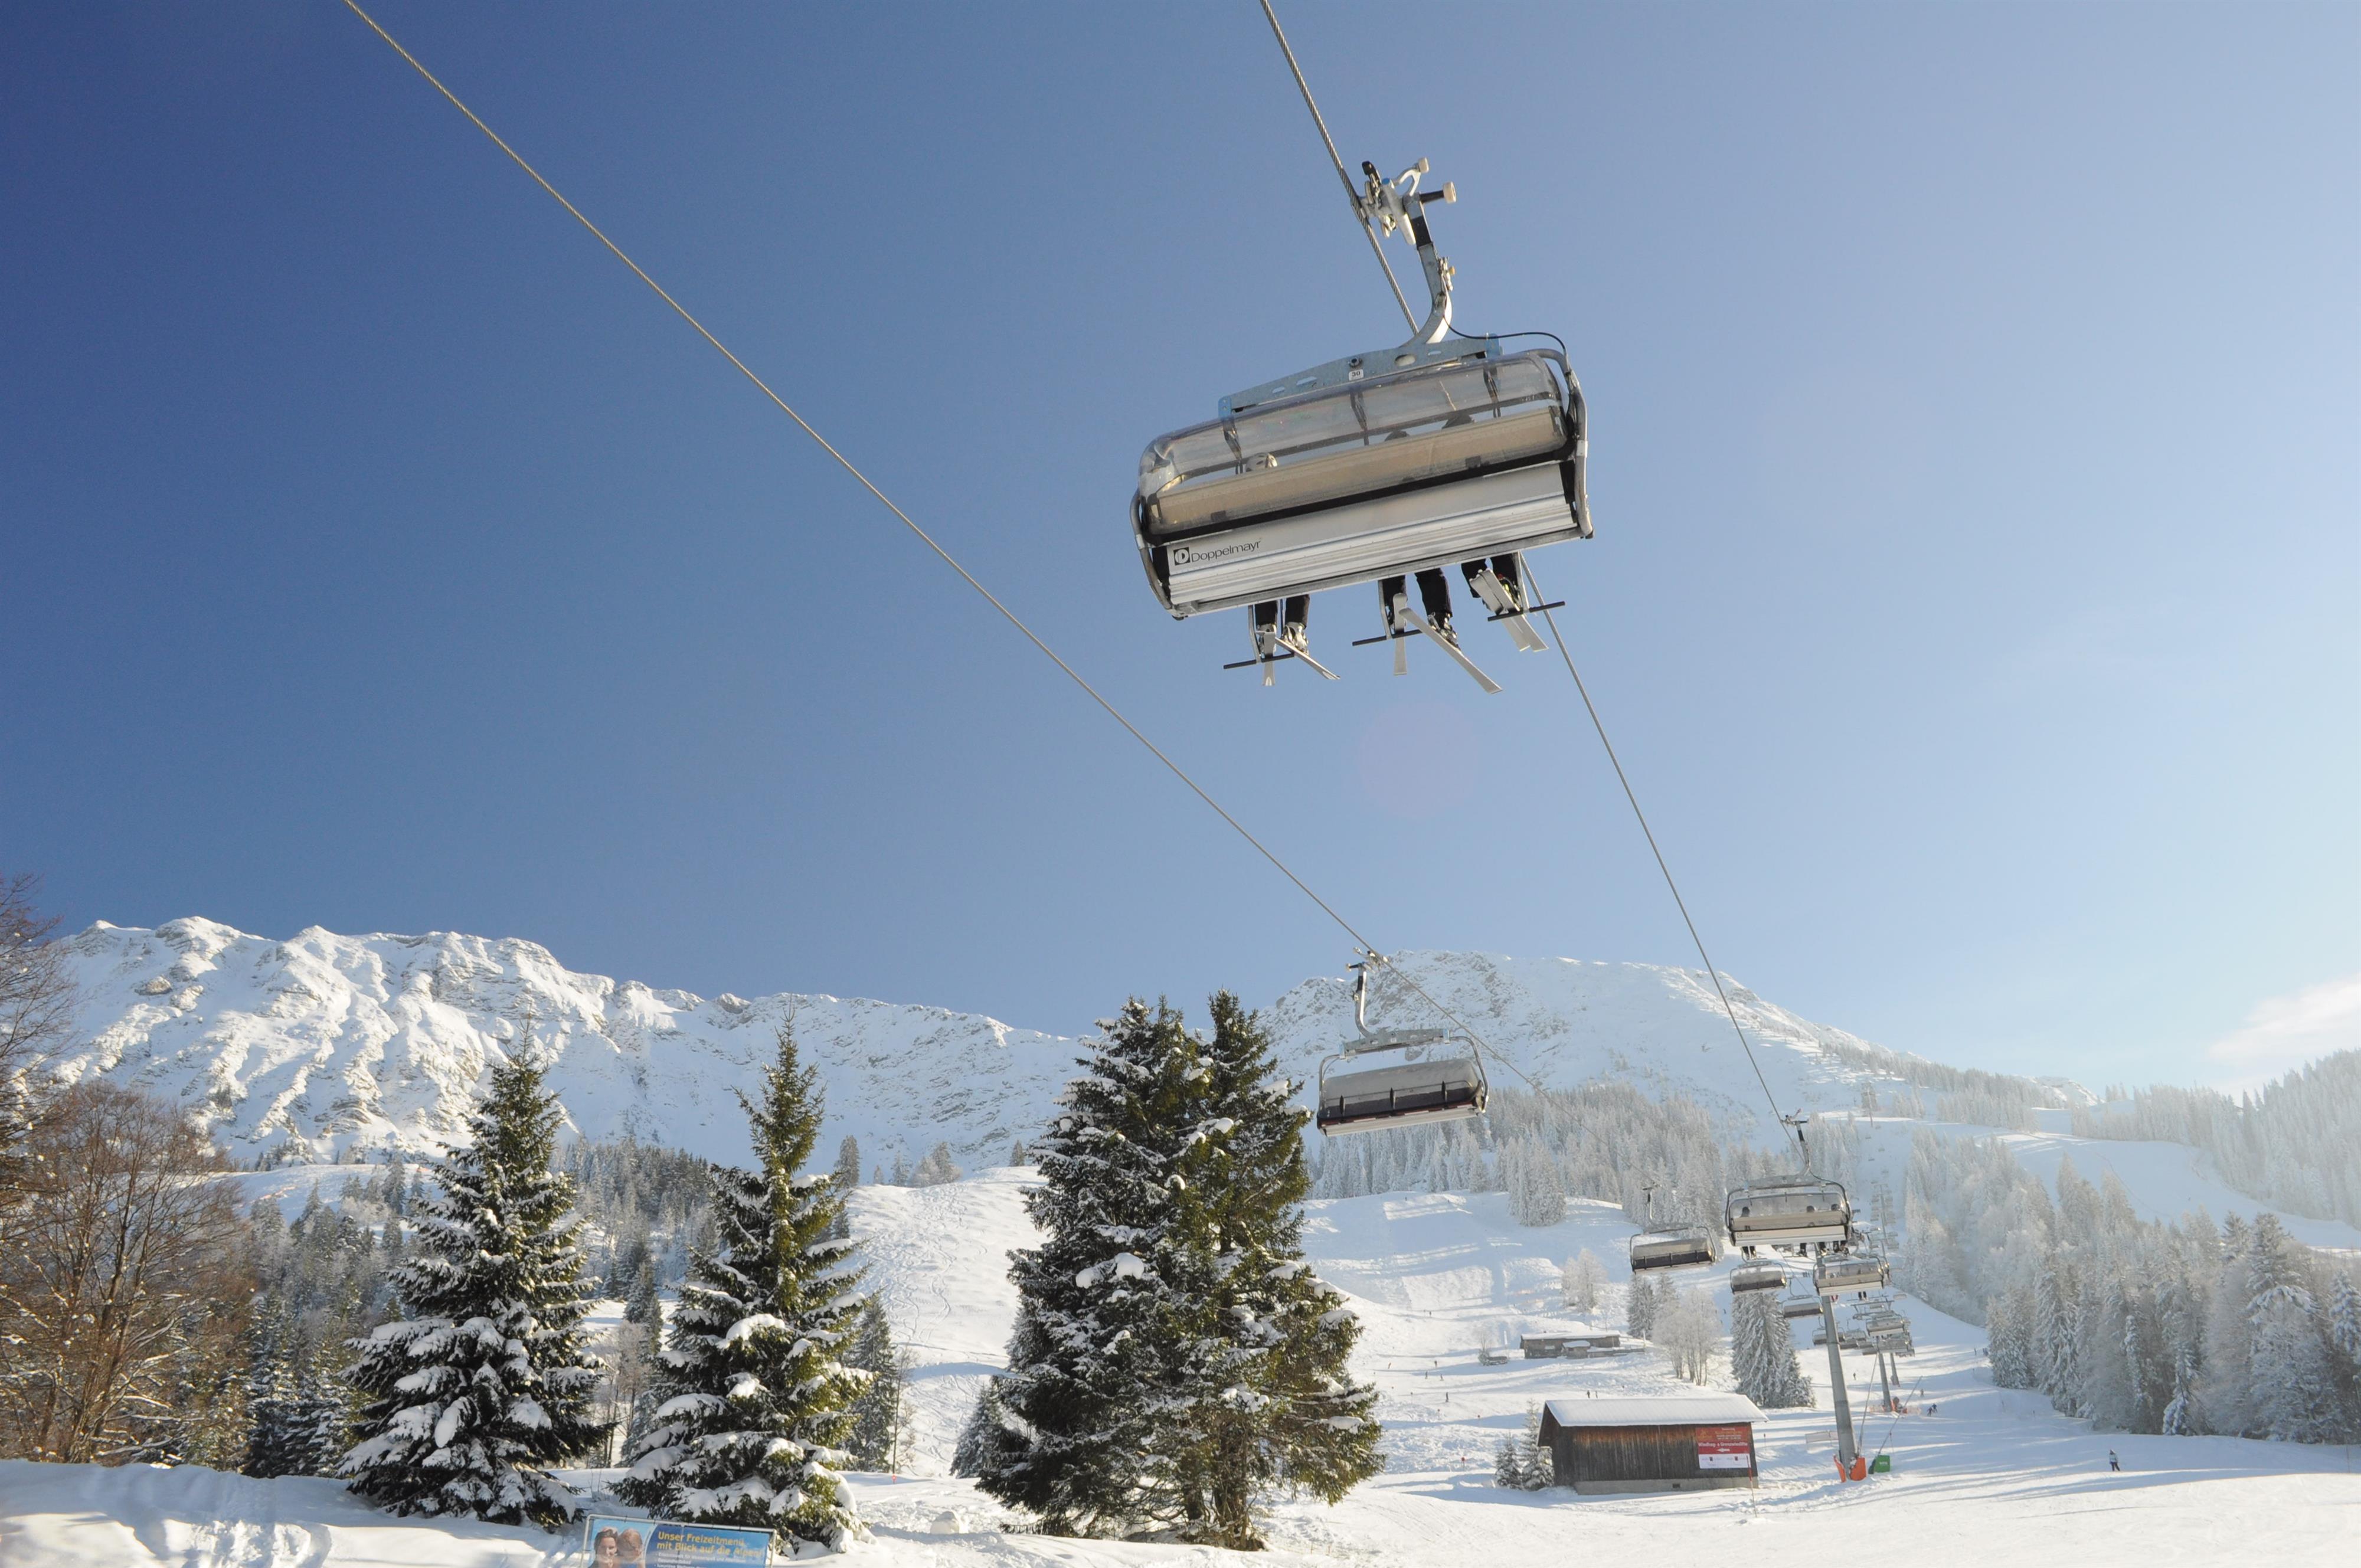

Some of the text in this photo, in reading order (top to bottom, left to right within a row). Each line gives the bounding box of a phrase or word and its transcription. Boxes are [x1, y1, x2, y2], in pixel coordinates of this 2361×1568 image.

[1191, 541, 1261, 562] Doppelmayr
[658, 1531, 684, 1542] Unser
[657, 1541, 672, 1550] mit
[675, 1542, 696, 1552] Blick
[699, 1544, 715, 1554] auf
[717, 1546, 731, 1556] die
